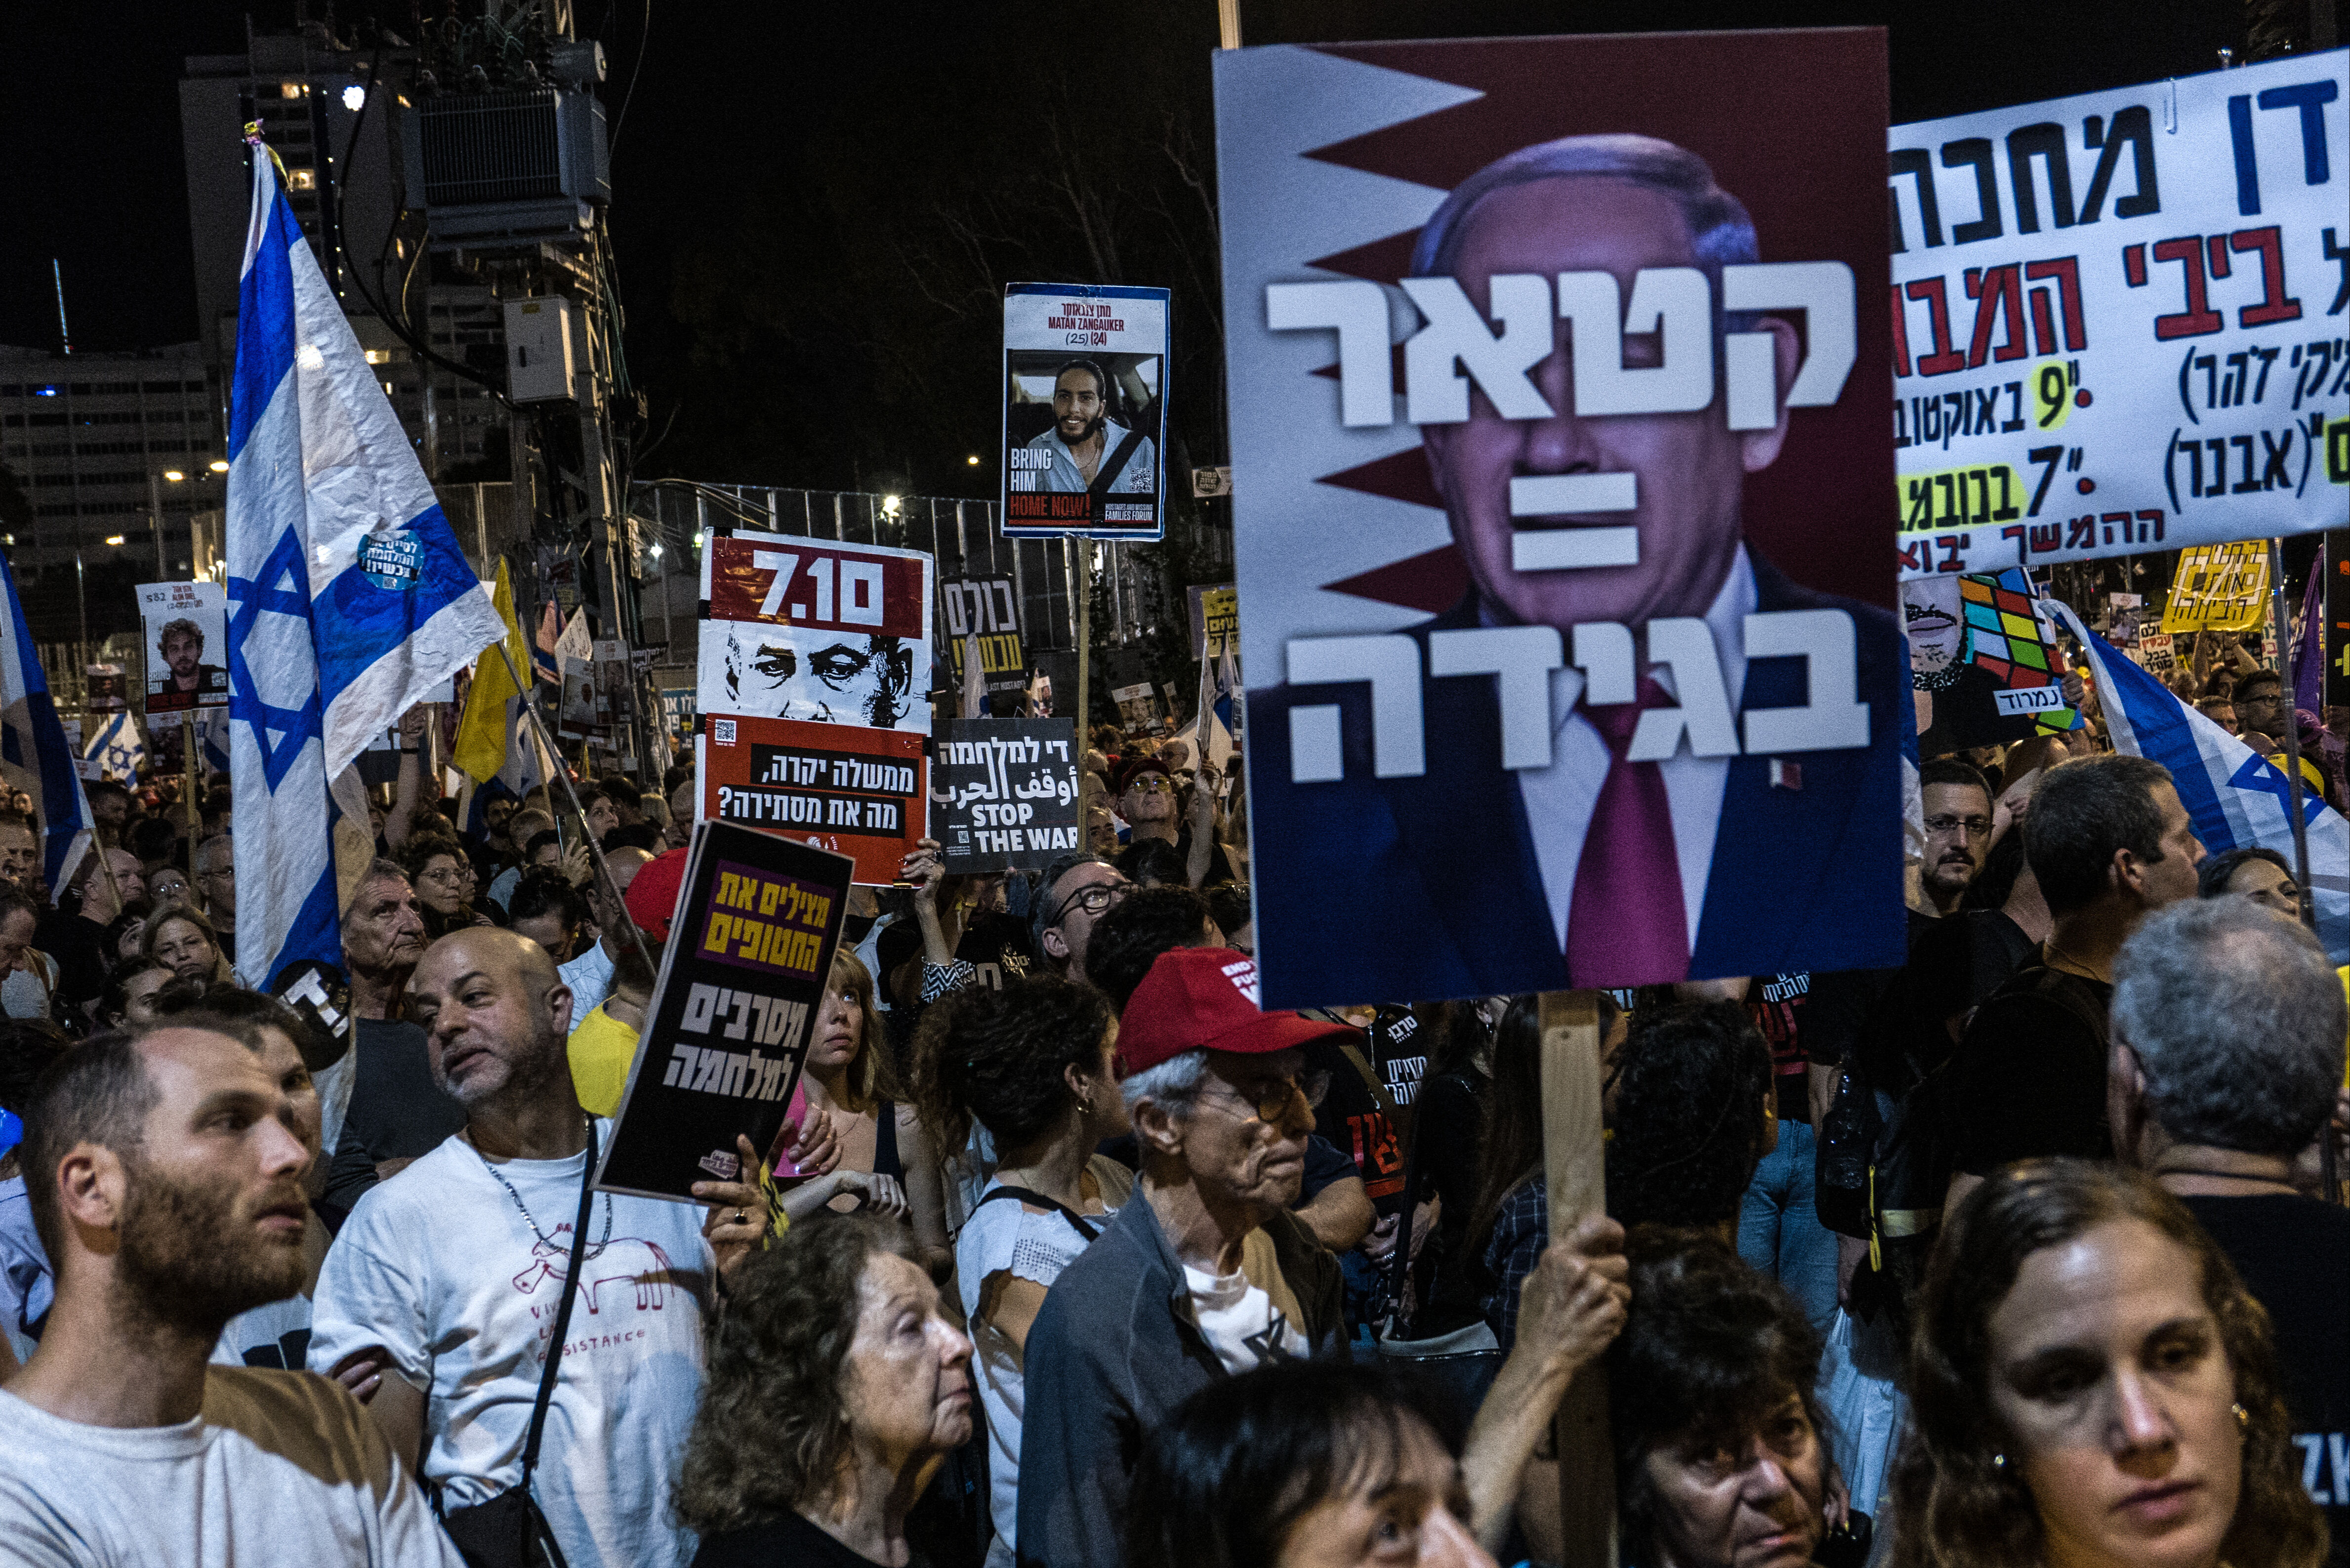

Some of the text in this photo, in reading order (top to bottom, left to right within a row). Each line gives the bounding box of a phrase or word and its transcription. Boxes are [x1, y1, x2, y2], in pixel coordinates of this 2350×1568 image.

[2123, 225, 2303, 341] ביבי
[1048, 317, 1124, 331] MATAN ZANGAUKER
[1096, 305, 1111, 318] מתן
[1066, 332, 1088, 346] (25)
[1266, 260, 1857, 431] קטאר
[1894, 381, 2024, 451] באוקטוב
[1011, 449, 1052, 469] BRING
[1010, 470, 1036, 492] HIM
[1897, 465, 2020, 531] בנובמ
[1010, 494, 1091, 517] HOME NOW!
[1105, 510, 1153, 521] FAMILIES FORUM
[2001, 509, 2163, 564] ההמשך
[367, 547, 414, 566] המלחמה
[146, 592, 166, 603] 582
[753, 550, 883, 627] 7.10
[944, 579, 1017, 635] כולם
[2141, 623, 2160, 637] ולם
[952, 634, 1023, 675] עכש!
[2144, 650, 2172, 661] בכל
[1286, 608, 1871, 784] בגידה
[1999, 690, 2059, 709] נמרוד
[939, 736, 1069, 772] די למלחמה
[761, 755, 914, 793] ממשלה יקרה,
[931, 766, 1078, 809] أوقف الحرب
[718, 786, 897, 830] מה את מסתירה?
[971, 803, 1033, 827] STOP
[974, 829, 1024, 853] THE
[1027, 826, 1078, 851] WAR
[715, 871, 831, 929] מצילים את
[704, 912, 823, 973] החטופים
[680, 983, 809, 1048] מסרבים
[662, 1043, 794, 1102] למלחמה
[537, 1329, 645, 1362] RSISTANCE
